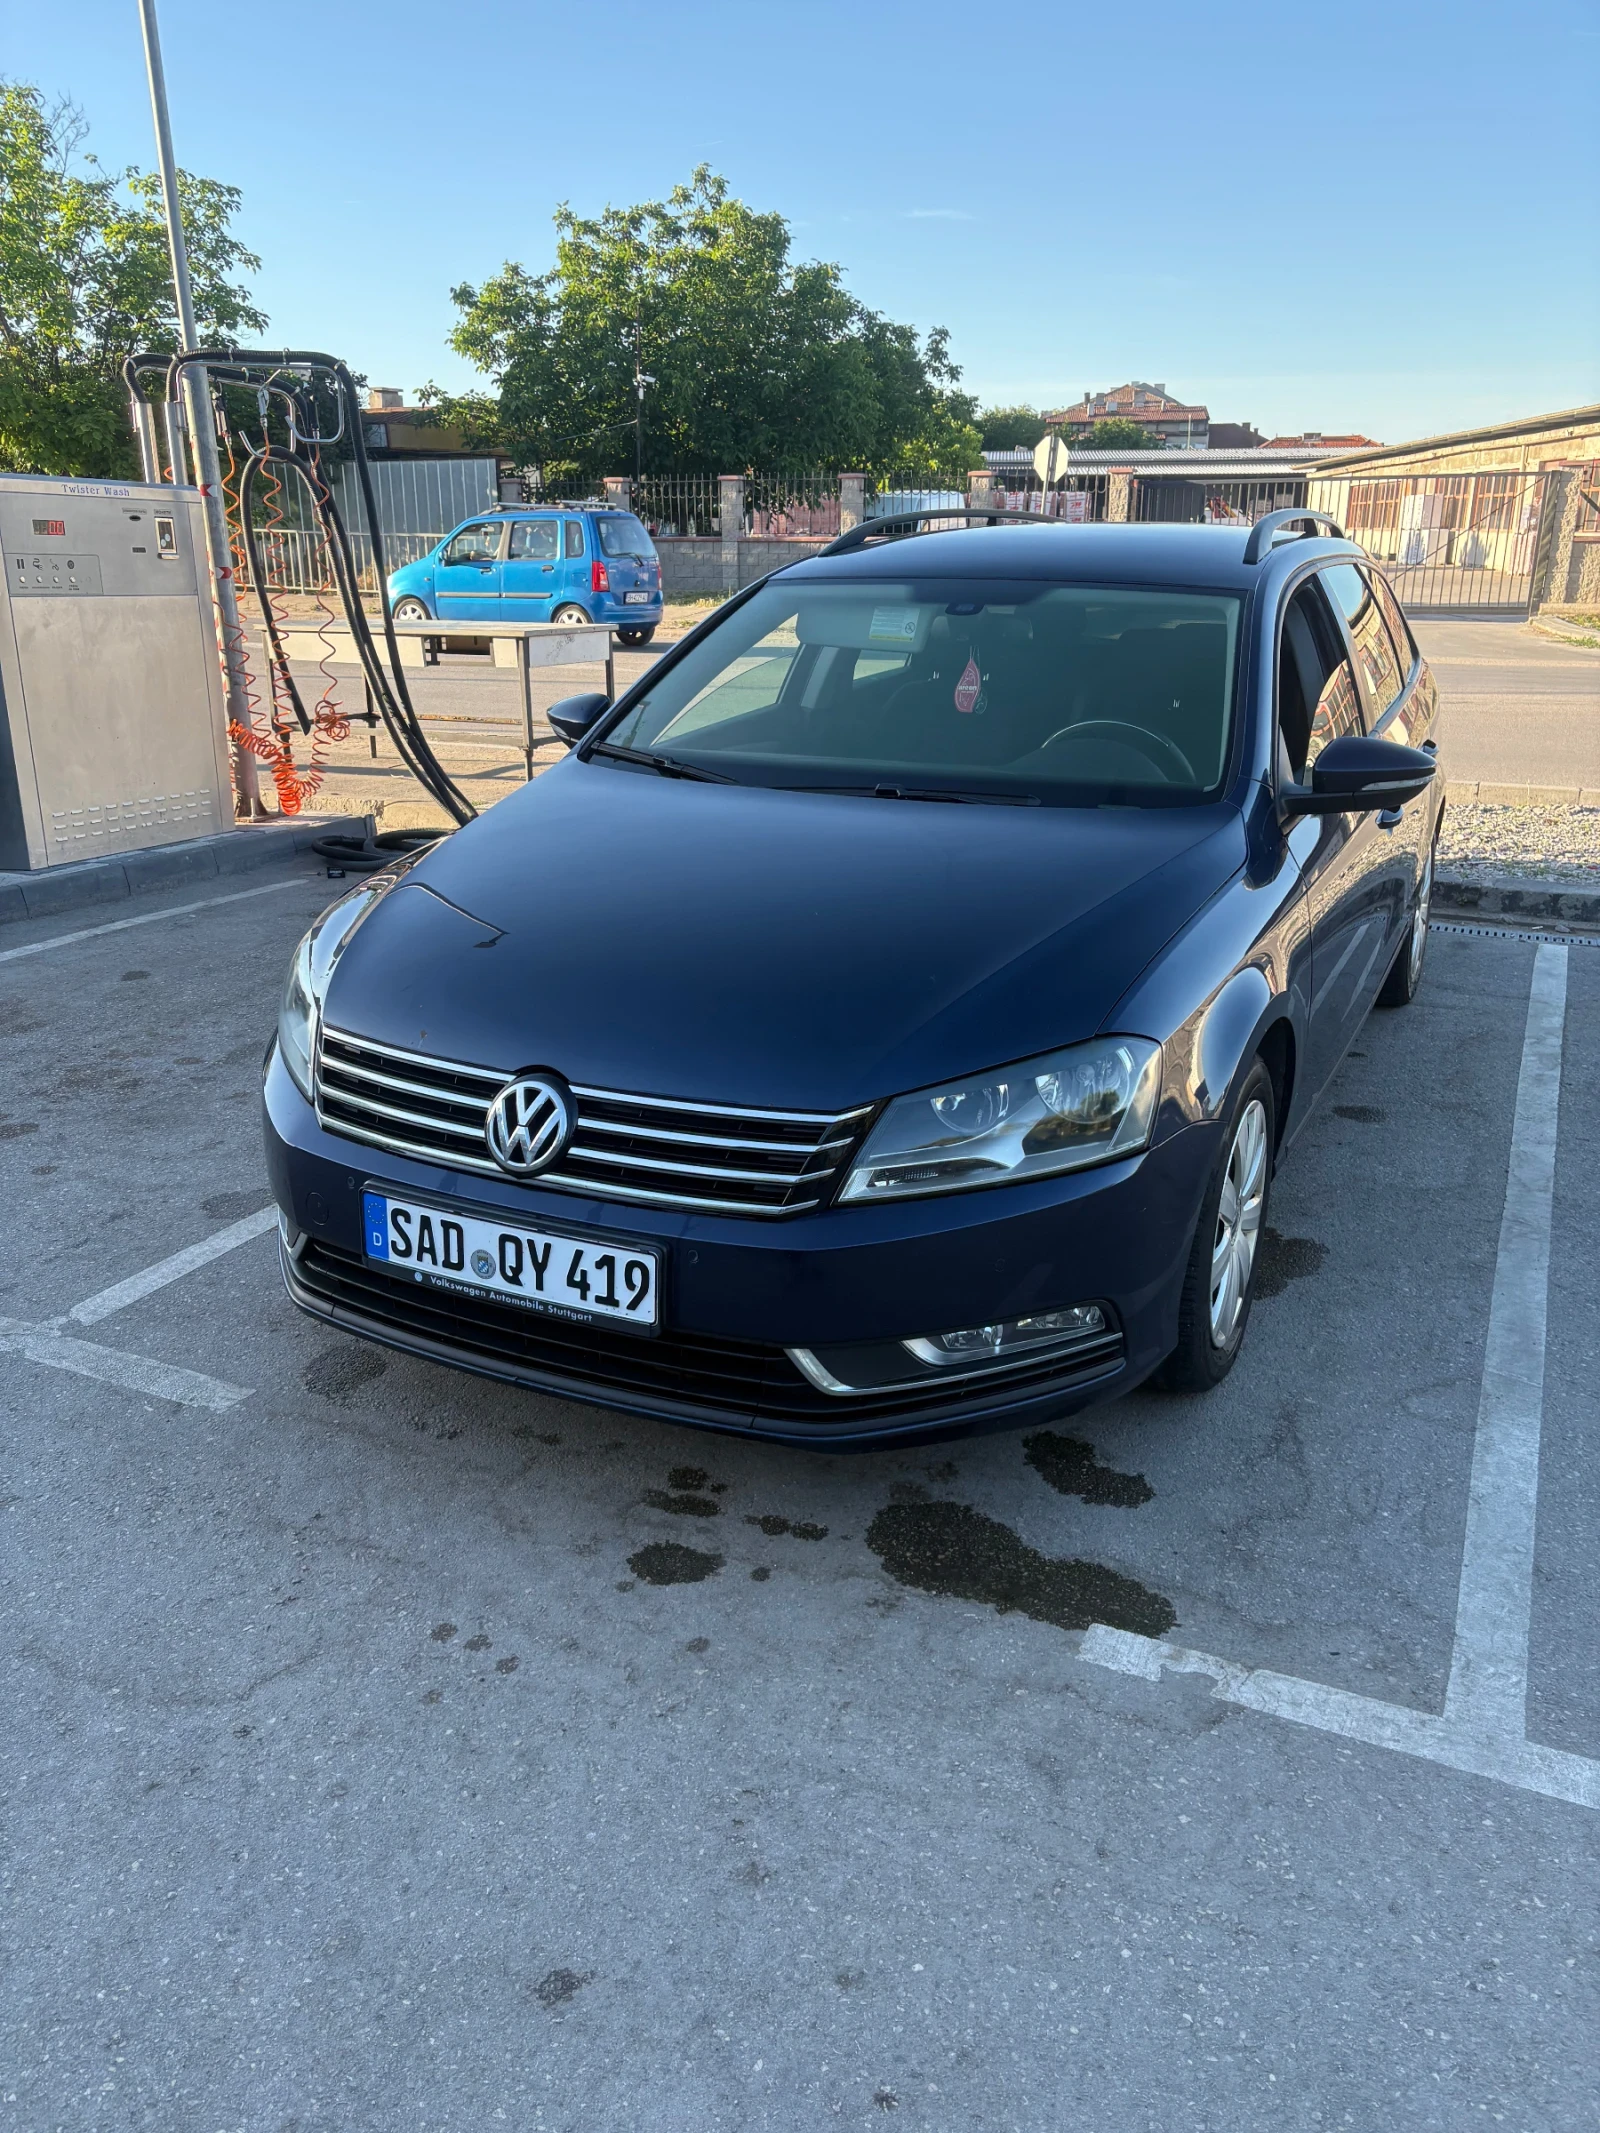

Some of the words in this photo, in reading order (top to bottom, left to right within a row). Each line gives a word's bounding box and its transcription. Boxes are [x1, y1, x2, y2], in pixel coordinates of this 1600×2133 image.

[61, 484, 100, 495] Twister
[104, 486, 130, 497] Wash
[488, 1081, 567, 1170] VW
[373, 1232, 382, 1247] D
[390, 1207, 465, 1272] SAD
[498, 1233, 552, 1292] QY
[566, 1248, 651, 1311] 419
[430, 1276, 486, 1297] Volkswagen
[489, 1291, 544, 1311] Automobile
[547, 1304, 593, 1322] Stuttgart
